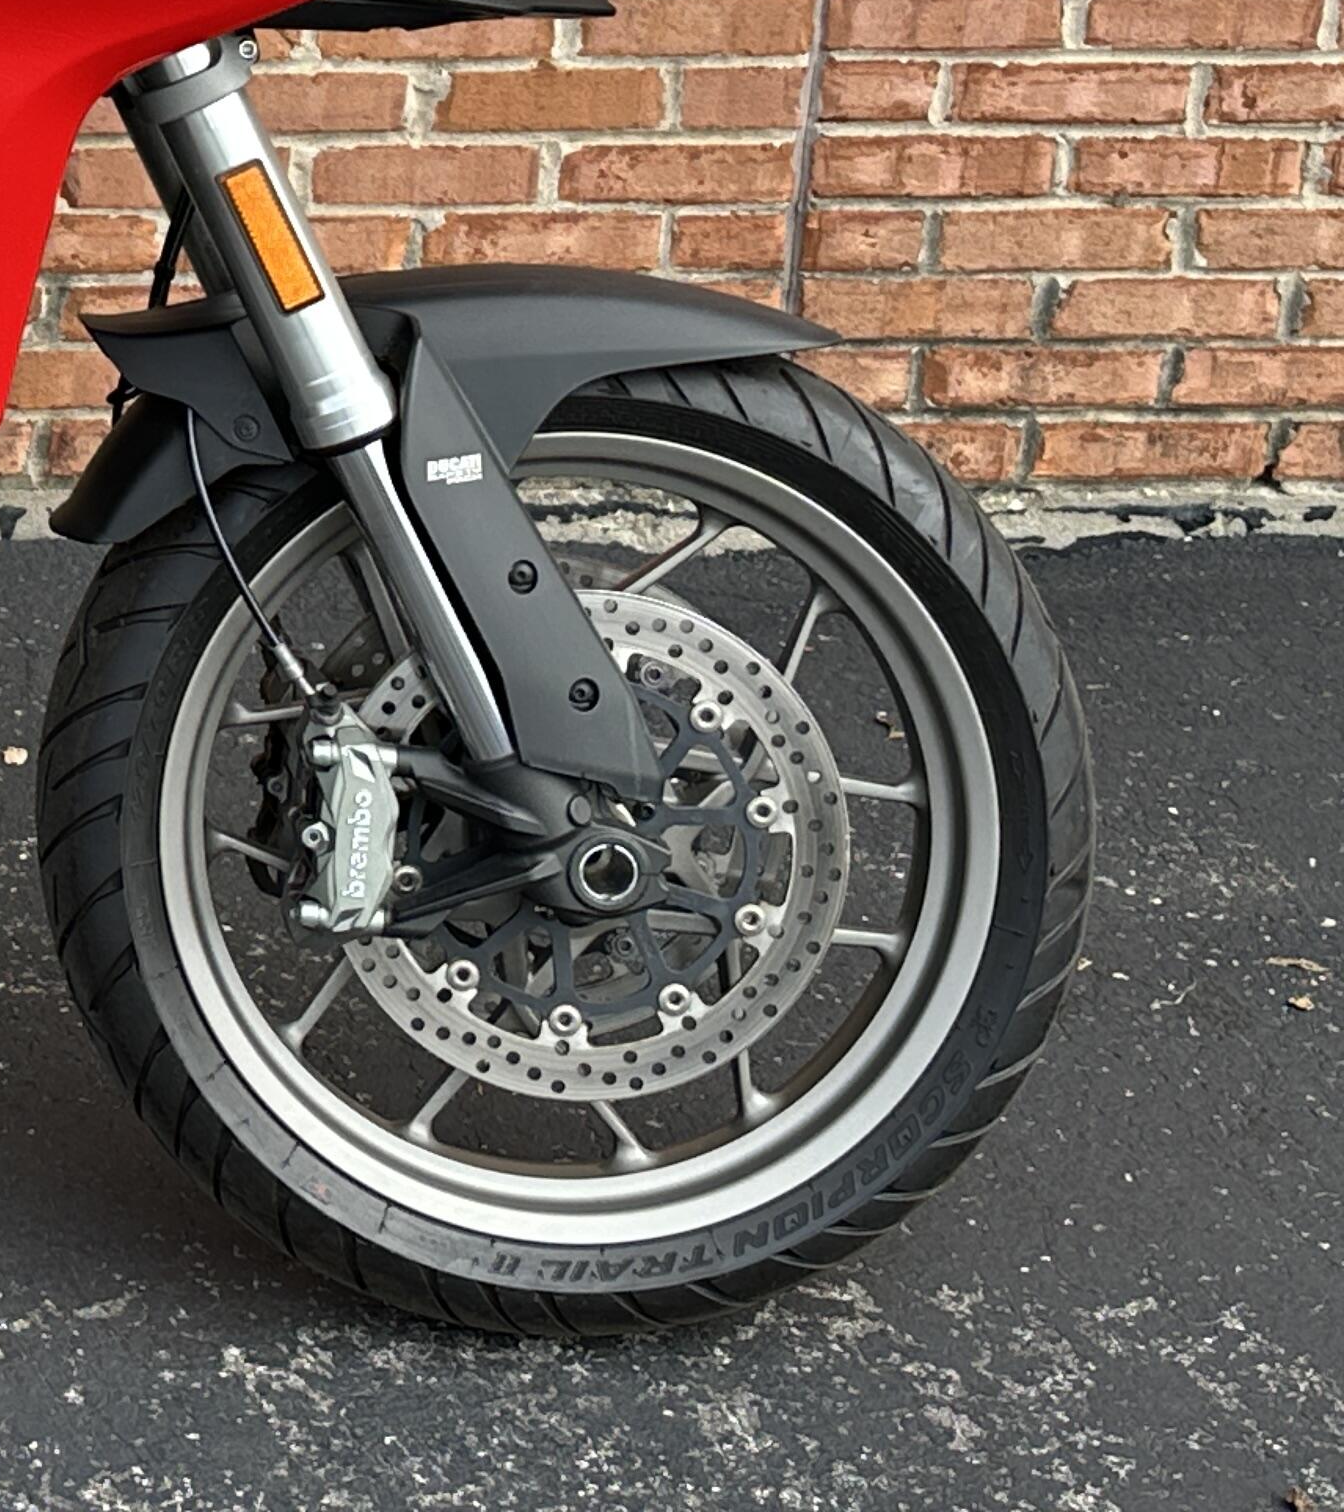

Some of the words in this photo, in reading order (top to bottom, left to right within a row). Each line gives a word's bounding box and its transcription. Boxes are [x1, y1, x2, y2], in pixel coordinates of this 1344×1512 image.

[341, 789, 372, 898] brembo
[732, 1048, 974, 1258] SCORPION
[539, 1242, 714, 1283] TRAIL
